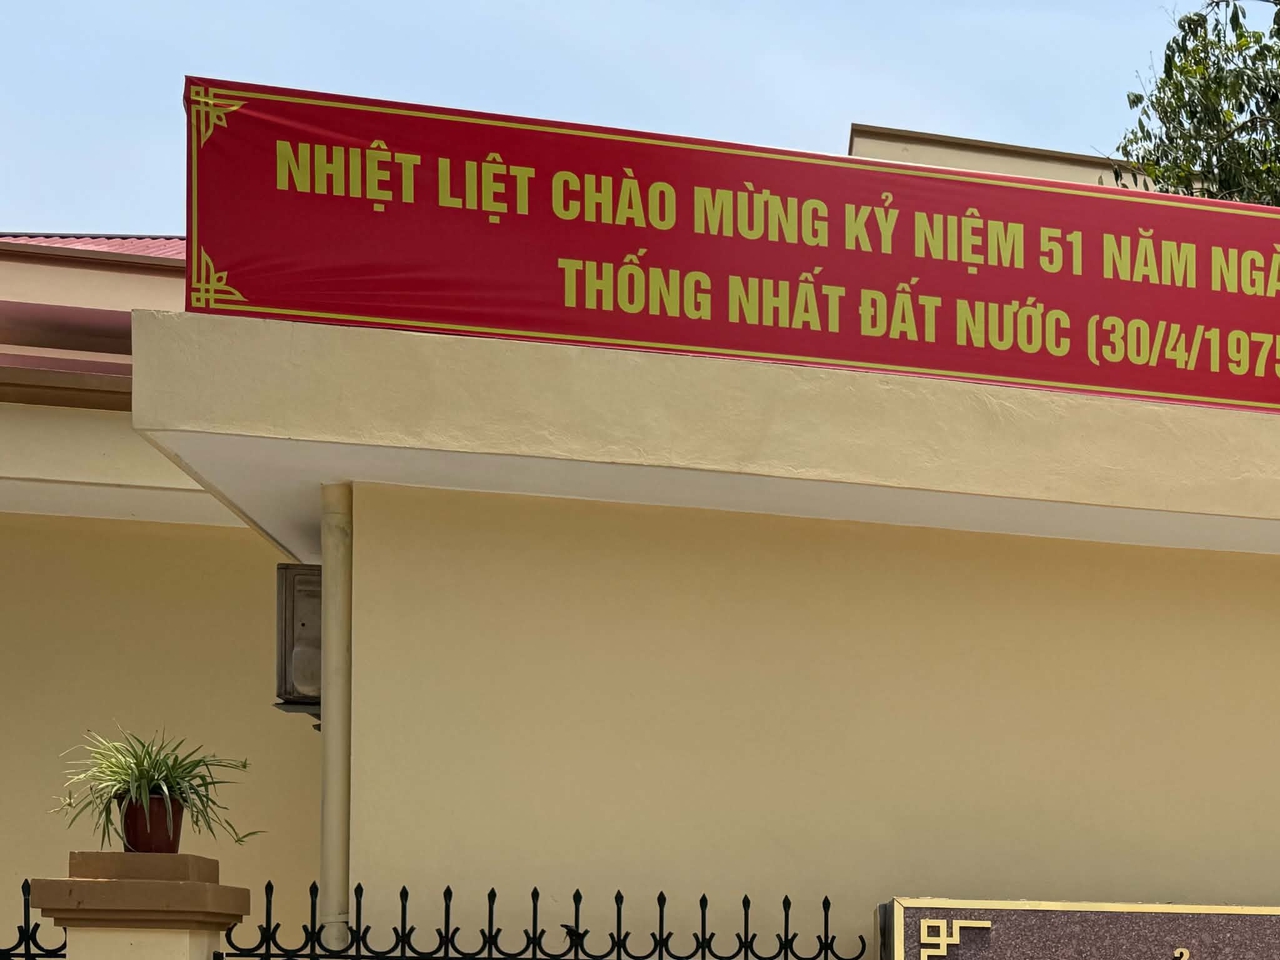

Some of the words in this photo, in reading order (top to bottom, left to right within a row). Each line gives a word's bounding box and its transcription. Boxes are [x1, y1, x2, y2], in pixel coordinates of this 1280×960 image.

[277, 140, 420, 212] NHIỆT
[439, 152, 535, 224] LIỆT
[552, 167, 677, 231] CHÀO
[693, 181, 829, 248] MỪNG
[844, 191, 900, 255] KỶ
[914, 207, 1025, 276] NIỆM
[1040, 226, 1083, 275] 51
[1102, 227, 1197, 288] NĂM
[558, 248, 711, 321] THỐNG
[728, 266, 846, 333] NHẤT
[858, 276, 942, 343] ĐẤT
[956, 295, 1071, 357] NƯỚC
